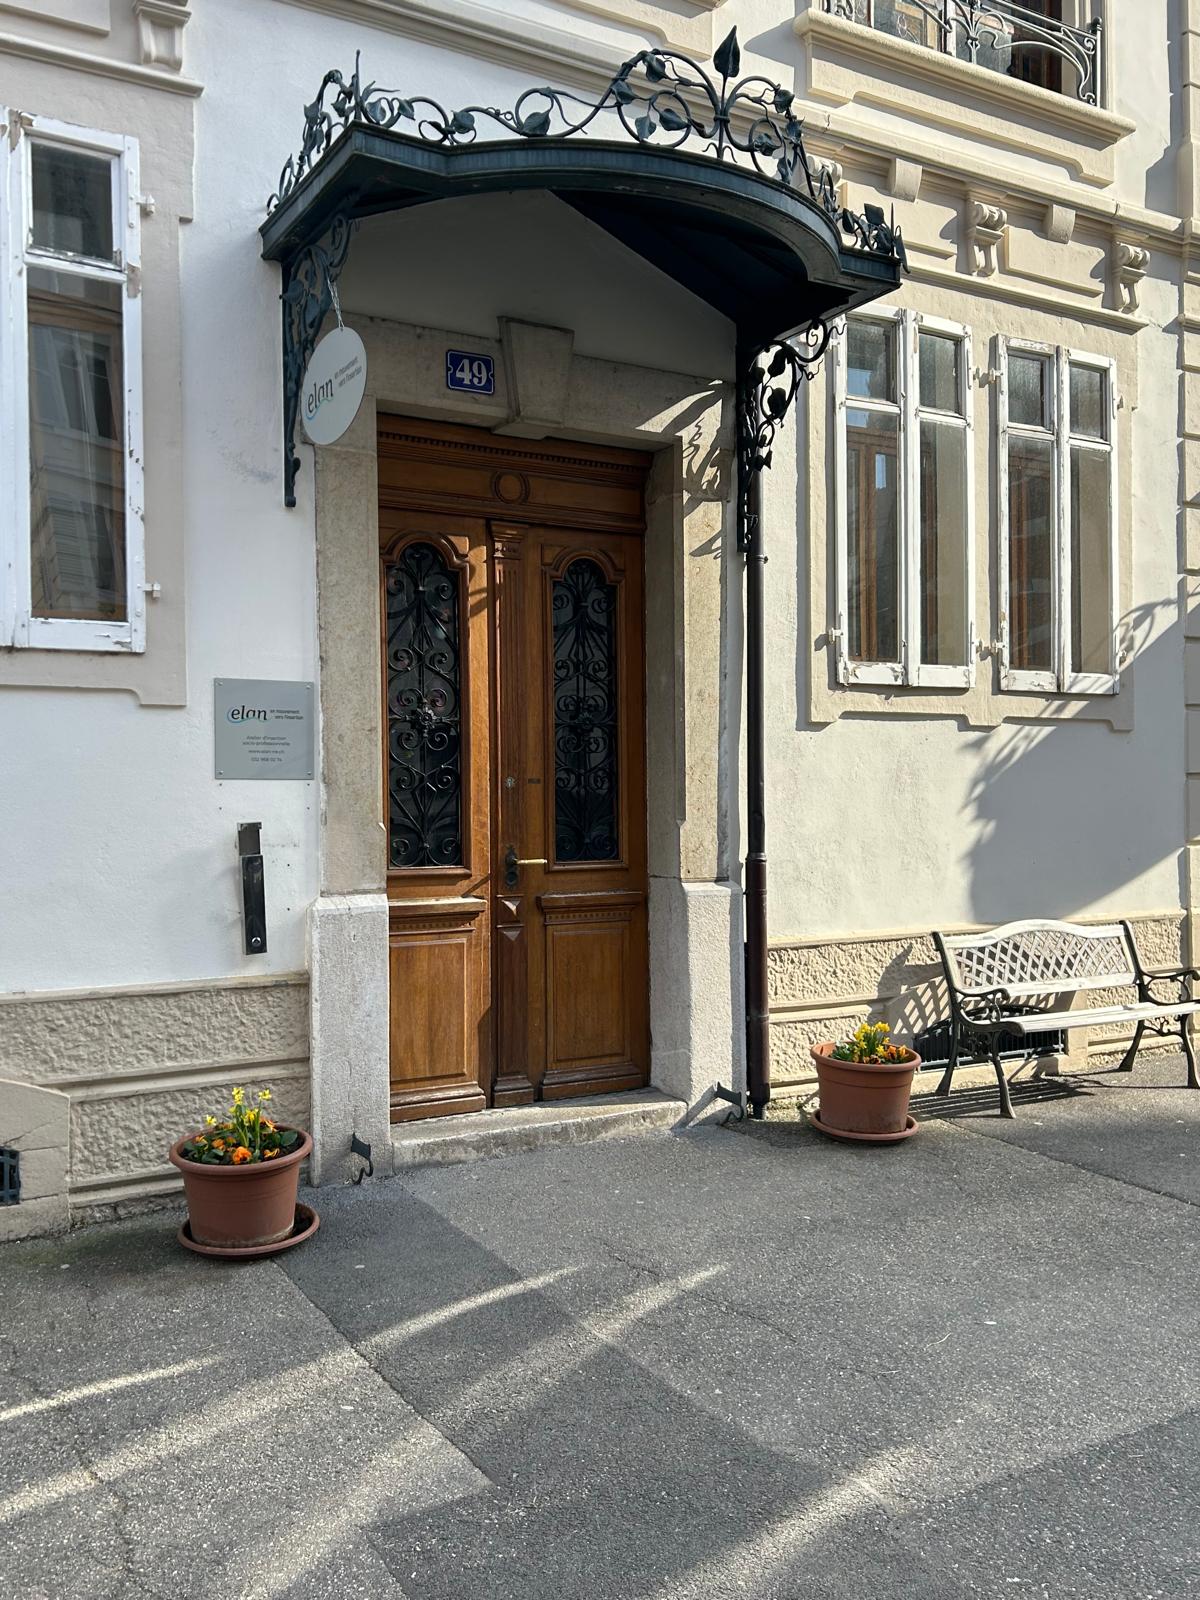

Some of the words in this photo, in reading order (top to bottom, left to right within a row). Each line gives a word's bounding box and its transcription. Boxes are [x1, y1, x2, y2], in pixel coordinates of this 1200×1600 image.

[456, 358, 487, 387] 49
[308, 378, 333, 413] elan
[231, 705, 267, 721] elan
